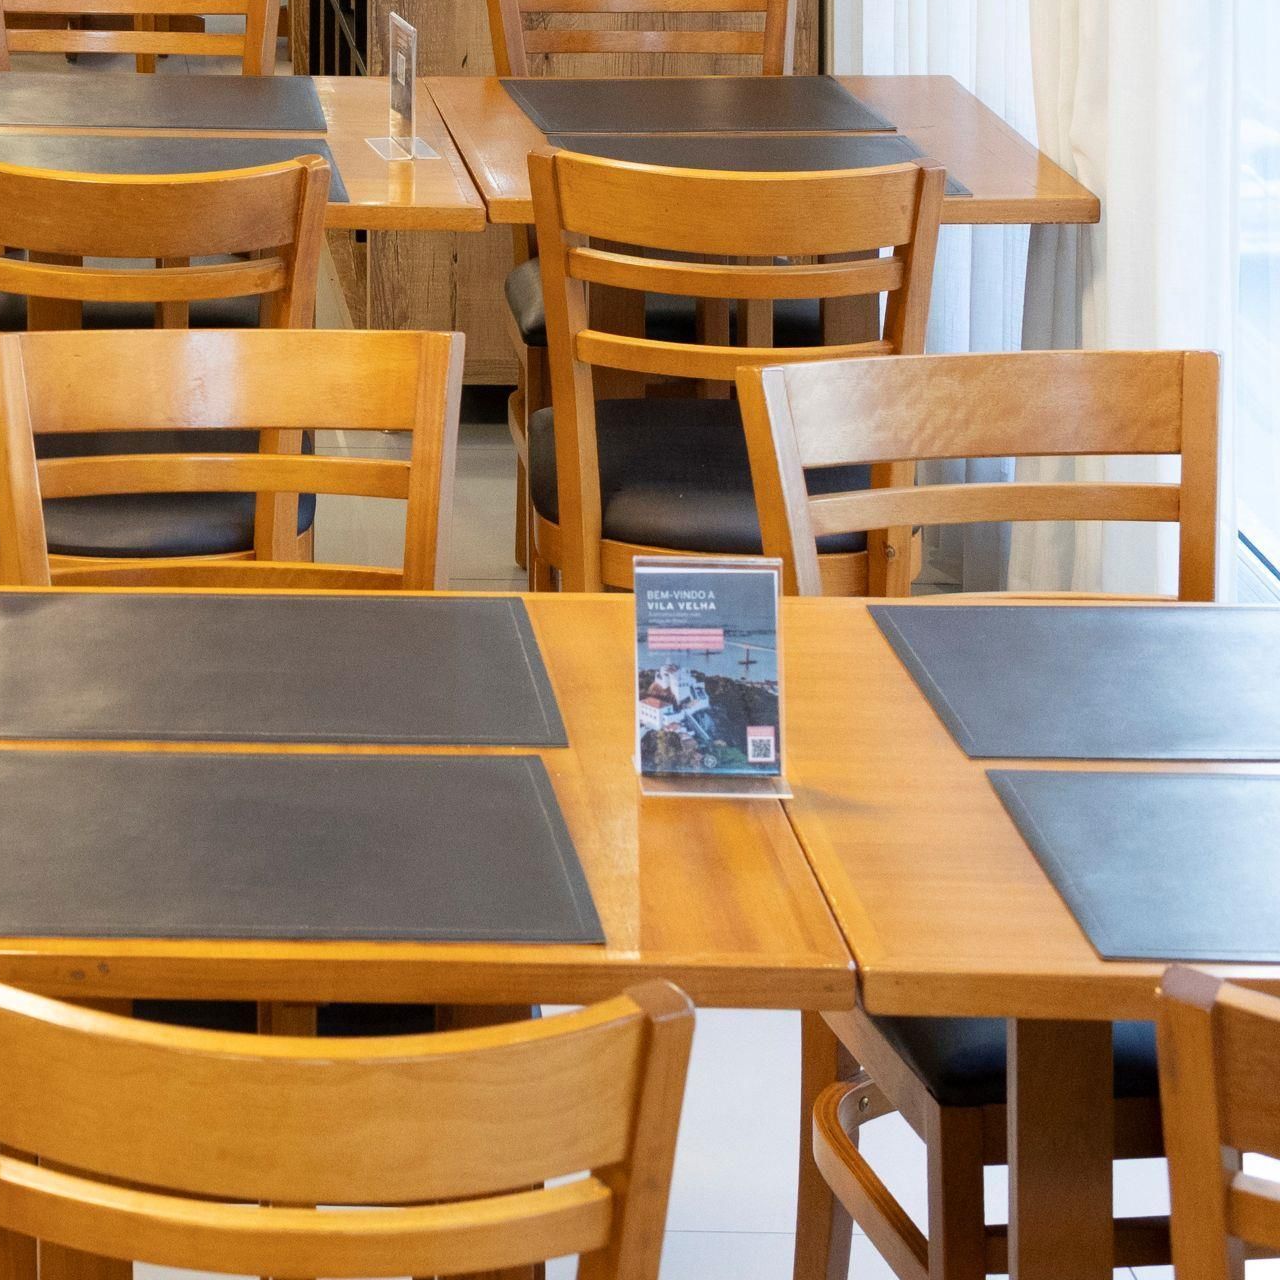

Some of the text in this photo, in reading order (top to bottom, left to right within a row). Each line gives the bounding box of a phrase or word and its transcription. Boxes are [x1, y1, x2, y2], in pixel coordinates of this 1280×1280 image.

[647, 590, 716, 600] BEM-VINDO A
[647, 601, 716, 610] VILA VELHA
